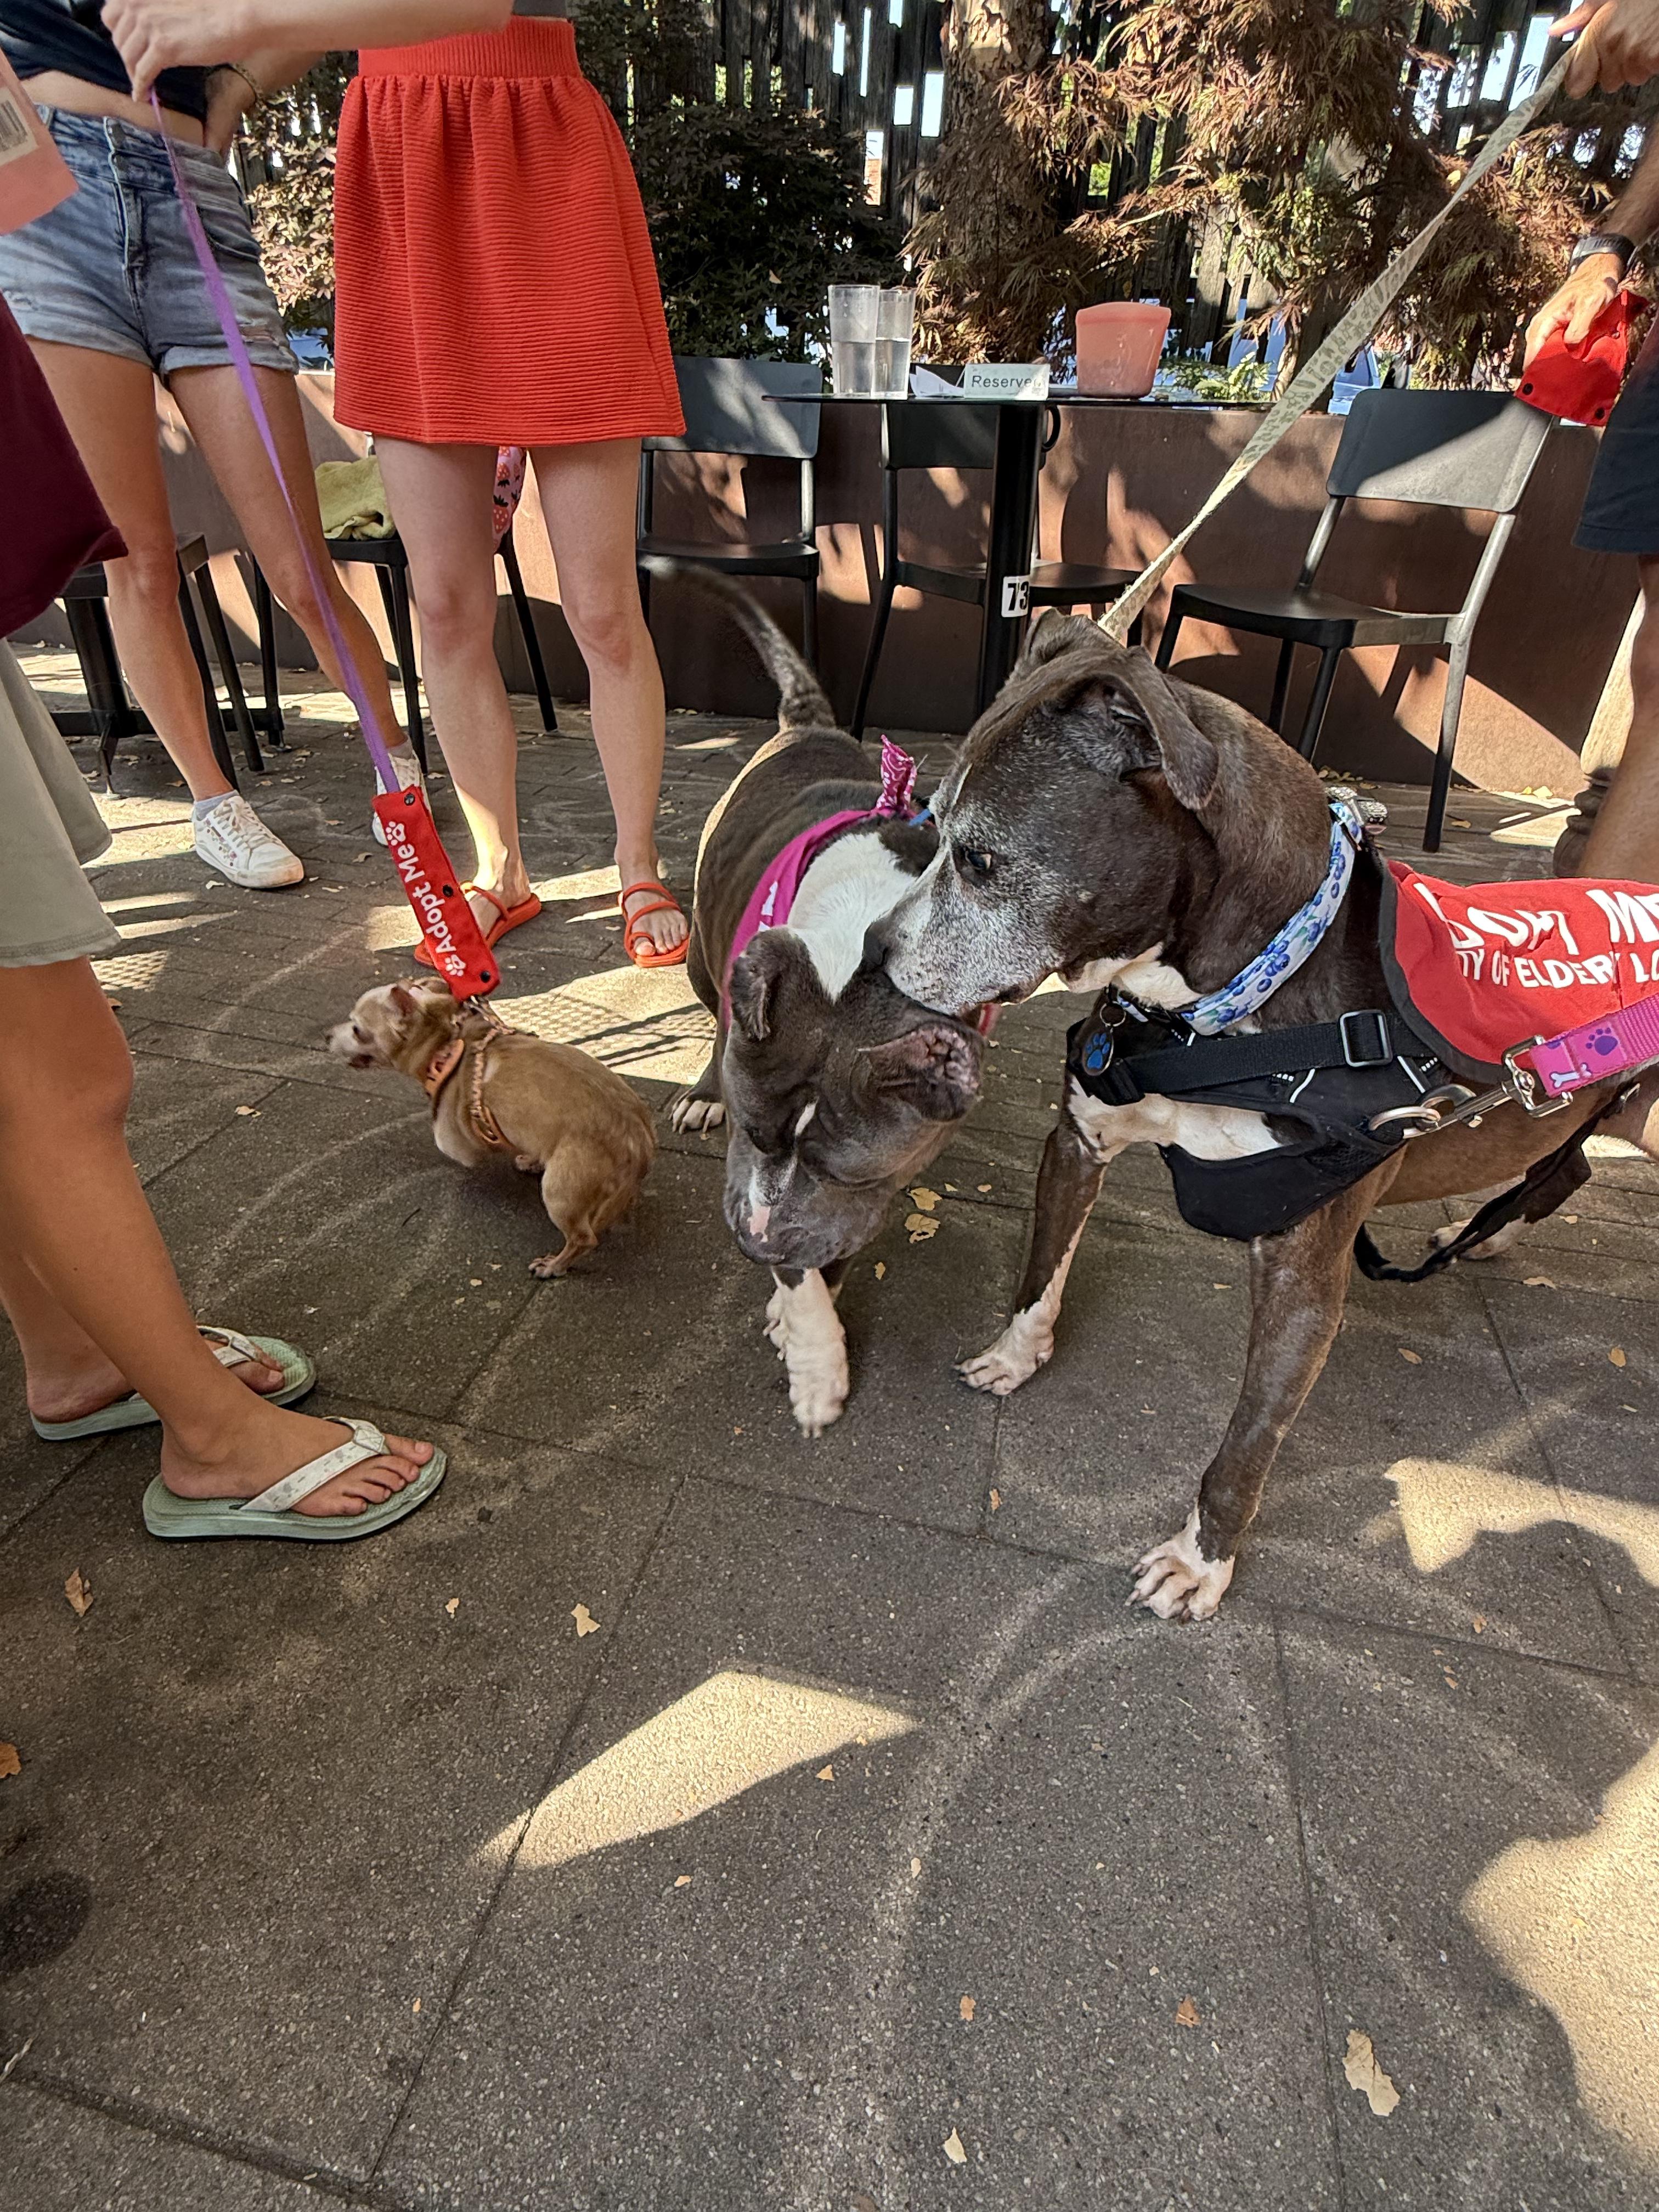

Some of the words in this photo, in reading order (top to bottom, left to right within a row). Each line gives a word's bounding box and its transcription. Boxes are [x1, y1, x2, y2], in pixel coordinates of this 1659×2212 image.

[972, 375, 1041, 388] Reserve
[1007, 581, 1029, 611] 73
[397, 843, 426, 883] Me
[411, 881, 457, 954] Adopt
[1455, 949, 1485, 980] TY
[1491, 950, 1510, 987] OF
